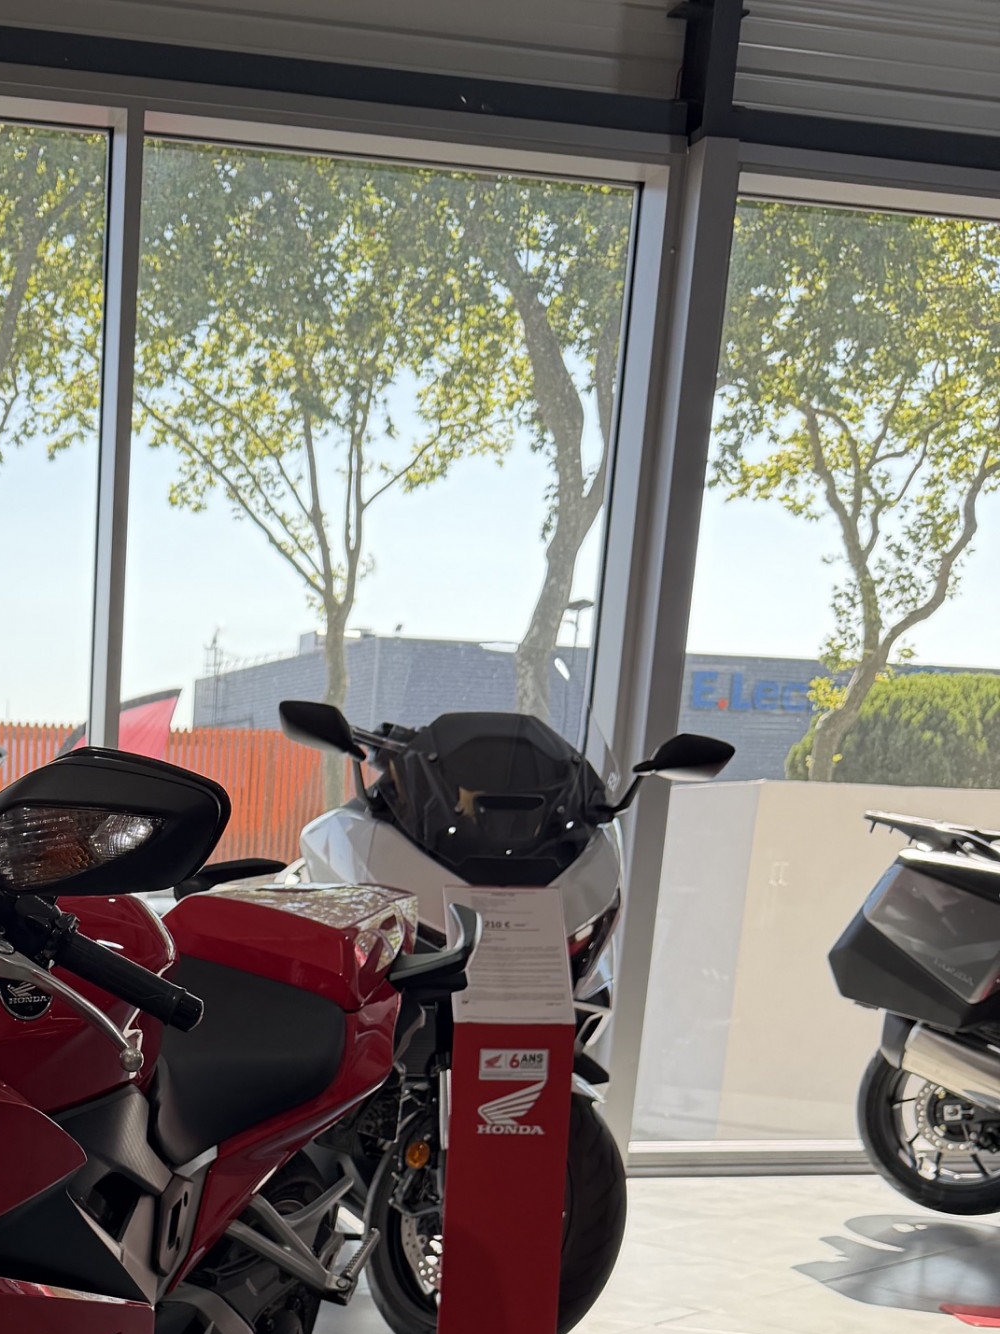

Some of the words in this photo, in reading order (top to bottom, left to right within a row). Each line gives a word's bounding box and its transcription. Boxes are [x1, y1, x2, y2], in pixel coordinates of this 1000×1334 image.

[8, 995, 49, 1005] HONDA
[509, 1053, 520, 1069] 6
[521, 1053, 544, 1063] ANS
[477, 1124, 545, 1135] HONDA
